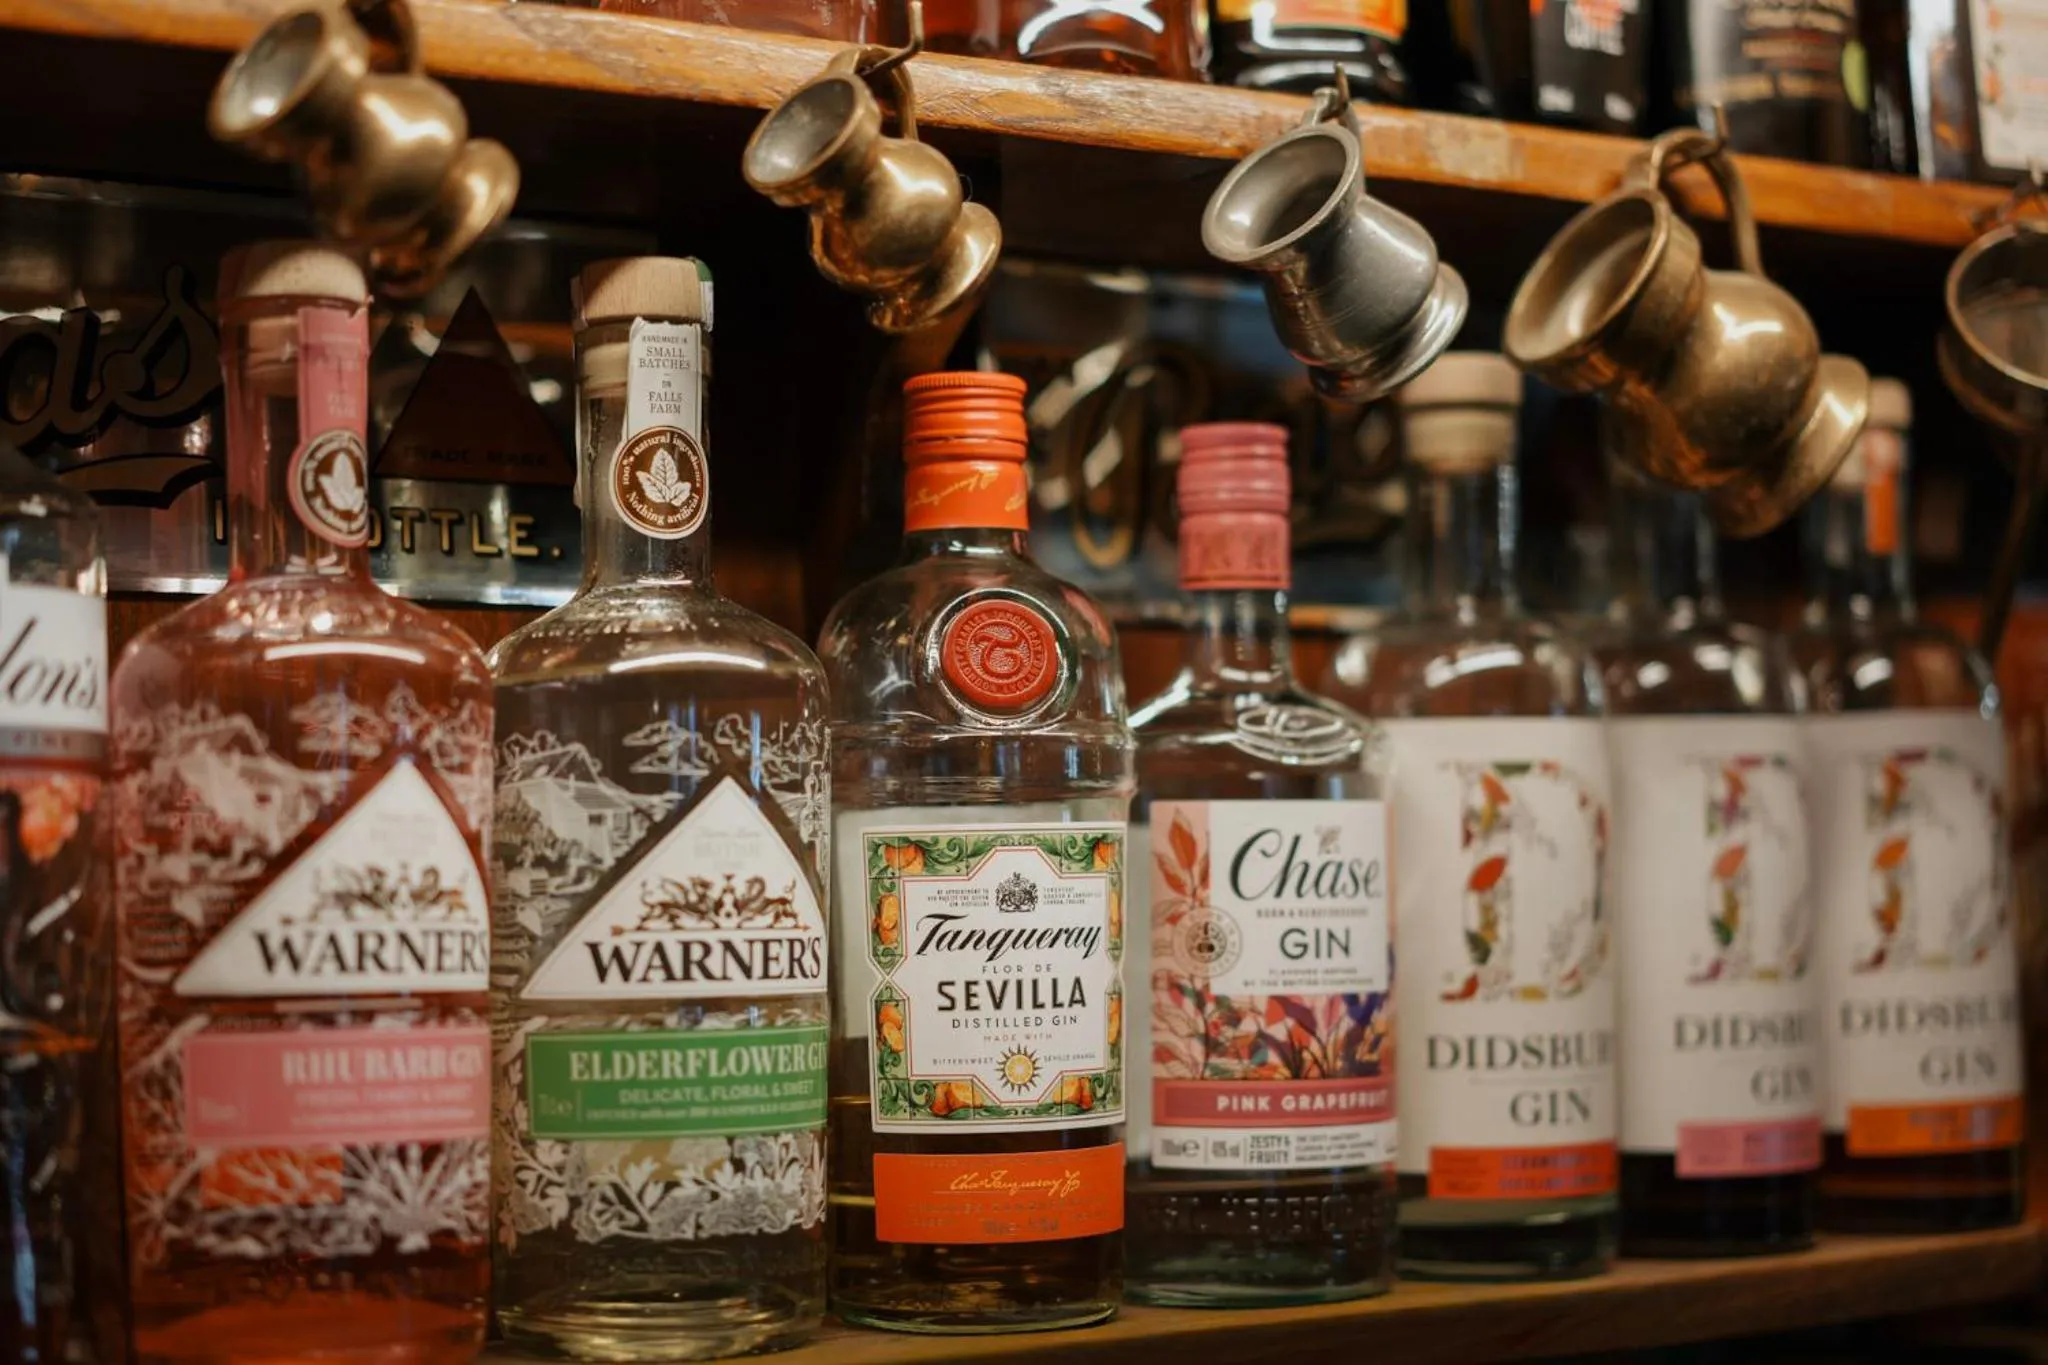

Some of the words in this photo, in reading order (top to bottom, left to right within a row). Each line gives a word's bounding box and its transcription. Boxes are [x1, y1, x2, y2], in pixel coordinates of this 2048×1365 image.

[641, 335, 680, 344] HANDMADE
[639, 358, 691, 370] BATCHES
[646, 347, 685, 358] SMALL
[649, 392, 683, 402] FALLS
[650, 403, 682, 414] FARM
[632, 431, 671, 456] natural
[672, 433, 701, 488] ingredients
[626, 490, 666, 525] Nothing
[667, 493, 700, 525] artificial
[366, 507, 563, 557] TTLE.
[1229, 828, 1381, 901] Chase
[916, 913, 1102, 963] Tanqueray
[1280, 927, 1351, 960] GIN
[583, 937, 821, 983] WARNER'S
[982, 964, 1024, 974] FLOR
[1035, 963, 1053, 973] DE
[937, 976, 1087, 1011] SEVILLA
[952, 1016, 1044, 1029] DISTILLED
[1052, 1015, 1077, 1026] GIN
[1674, 1012, 1812, 1052] DIDSB
[984, 1034, 1017, 1042] MADE
[1025, 1033, 1053, 1041] WITH
[569, 1044, 807, 1082] ELDERFLOWER
[933, 1058, 994, 1066] BITTERSWEET
[1919, 1049, 1998, 1086] GIN
[618, 1087, 709, 1105] DELICATE,
[711, 1084, 769, 1101] FLORAL
[1216, 1094, 1271, 1112] PINK
[1281, 1089, 1389, 1111] GRAPEFRUIT
[1509, 1089, 1591, 1127] GIN
[1249, 1135, 1284, 1149] ZESTY
[1249, 1149, 1290, 1164] FRUITY
